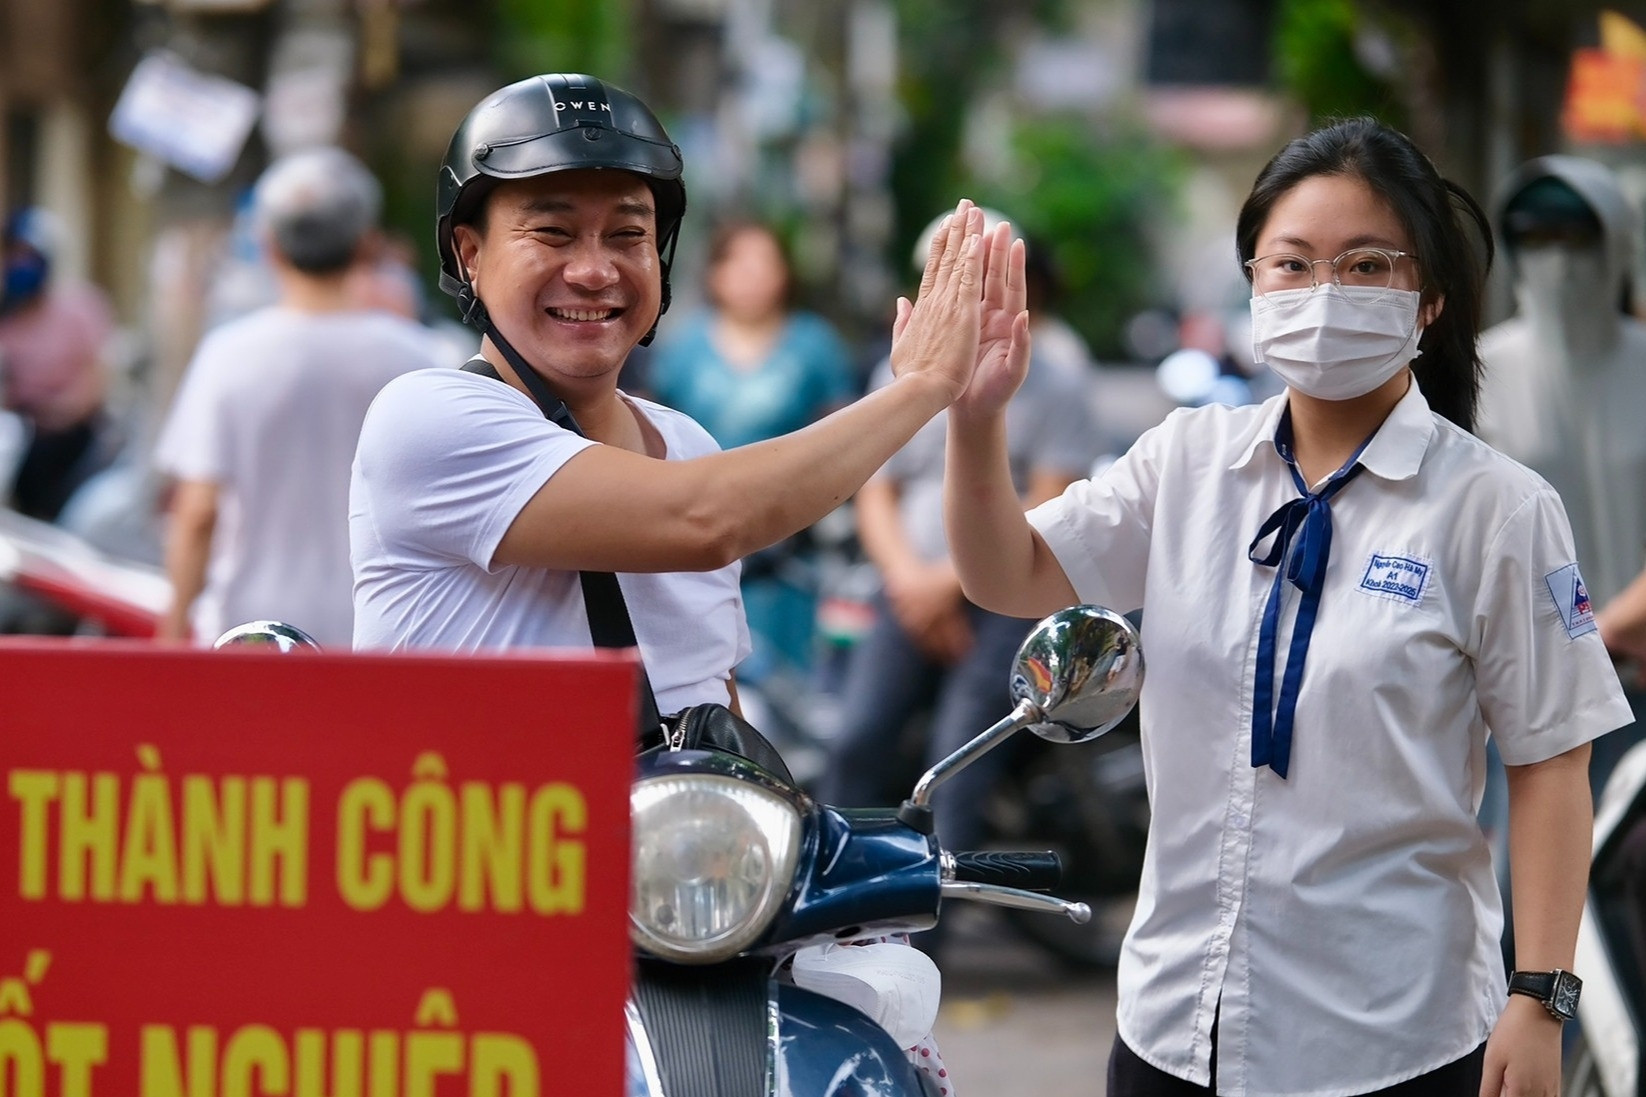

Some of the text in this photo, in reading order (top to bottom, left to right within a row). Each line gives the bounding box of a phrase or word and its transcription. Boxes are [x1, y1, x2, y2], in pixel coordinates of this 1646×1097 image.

[553, 101, 611, 112] OWEN
[1392, 561, 1403, 569] Cao
[1387, 571, 1398, 580] A1
[9, 744, 586, 914] THÀNH CÔNG
